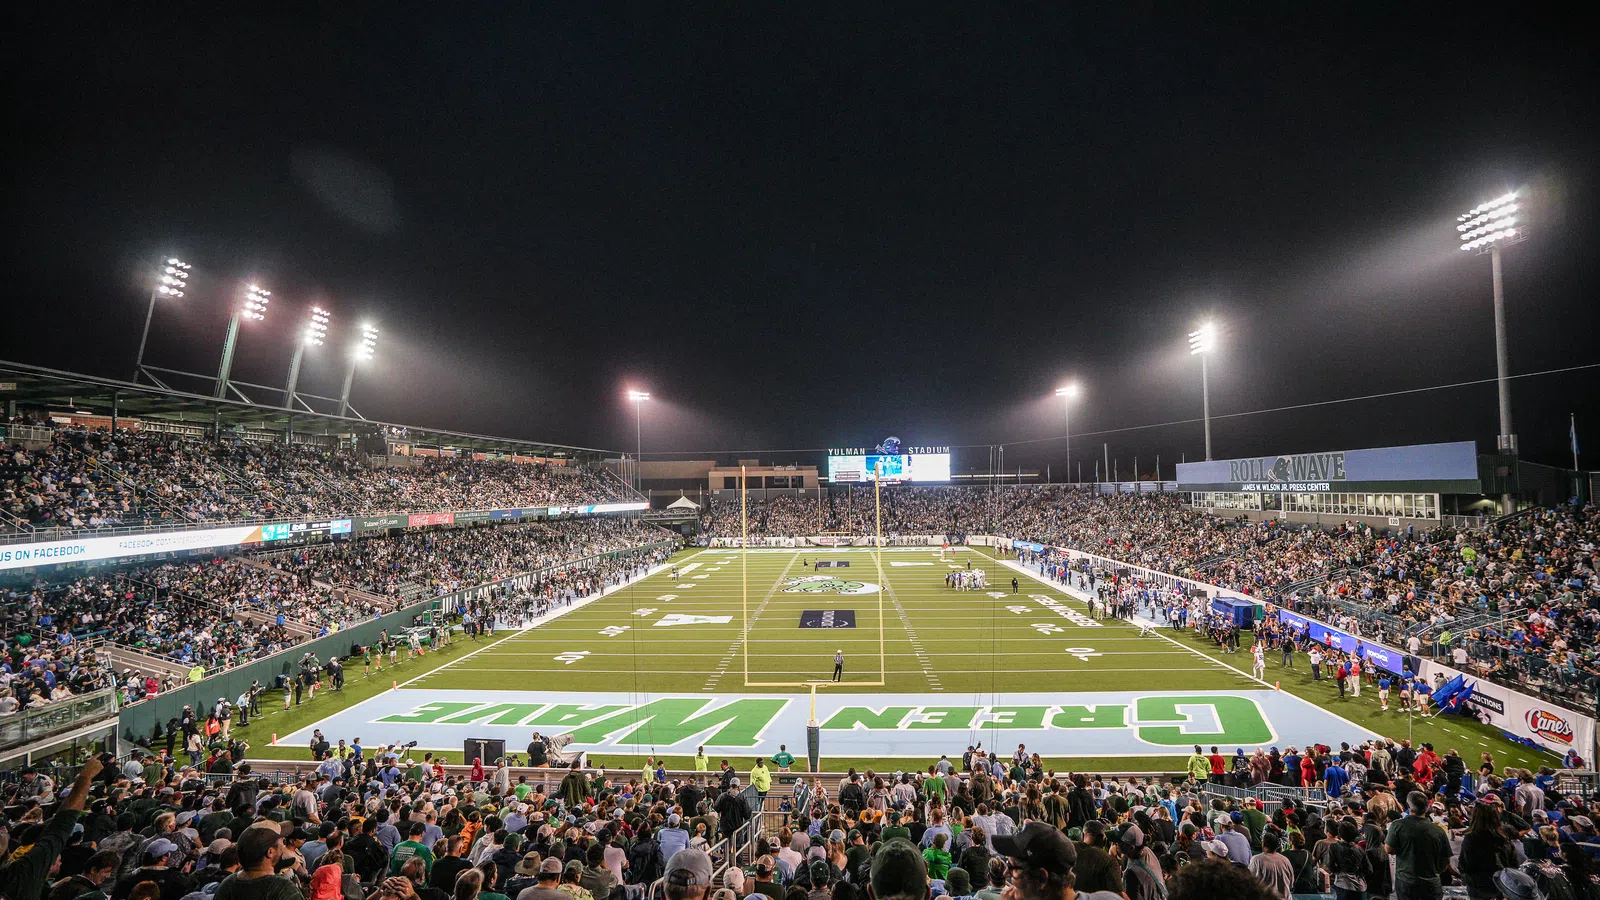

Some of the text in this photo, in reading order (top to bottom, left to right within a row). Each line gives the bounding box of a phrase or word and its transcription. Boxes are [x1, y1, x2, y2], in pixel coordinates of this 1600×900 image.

[828, 446, 950, 455] YULMAN STADIUM
[1229, 452, 1346, 483] ROLL WAVE
[1241, 483, 1256, 491] JAMES
[1262, 483, 1280, 491] WILSON
[1289, 483, 1306, 491] PRESS
[1306, 483, 1330, 491] CENTER
[14, 549, 31, 560] ON
[33, 544, 87, 558] FACEBOOK
[366, 695, 1279, 747] GREEN WAVE
[1527, 707, 1573, 736] Cane's
